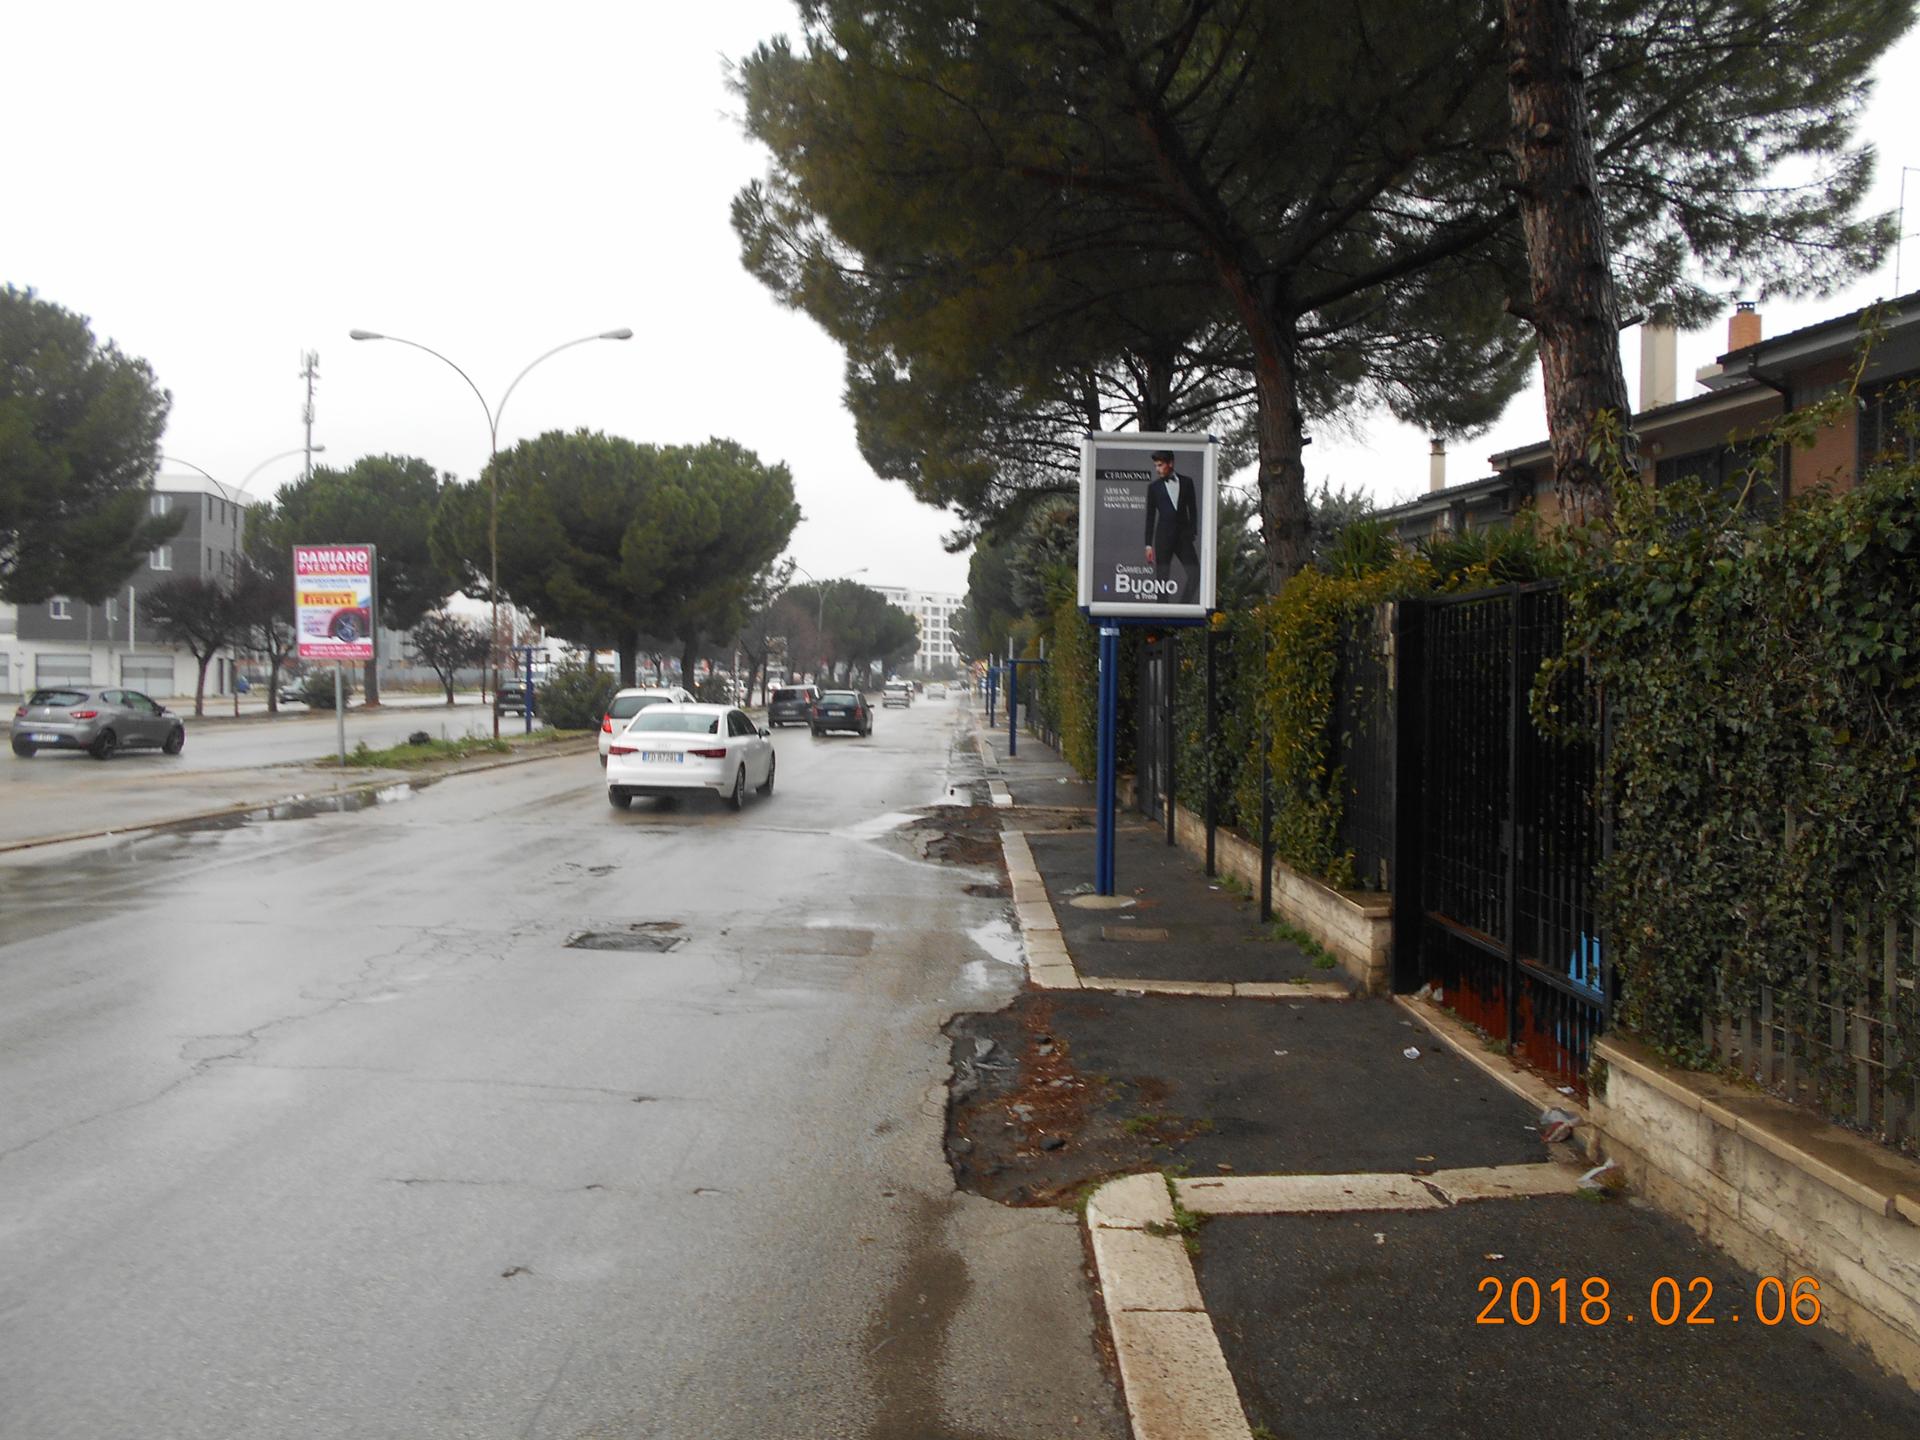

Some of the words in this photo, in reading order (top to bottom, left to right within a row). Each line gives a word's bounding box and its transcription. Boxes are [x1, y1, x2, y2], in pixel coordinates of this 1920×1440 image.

[1104, 471, 1151, 480] CERIMONIA
[1105, 487, 1130, 495] ARMANI
[298, 551, 368, 563] DAMIANO
[298, 562, 369, 572] PNEUMATICI
[1115, 574, 1178, 595] BUONO
[303, 592, 353, 605] PIRELLI
